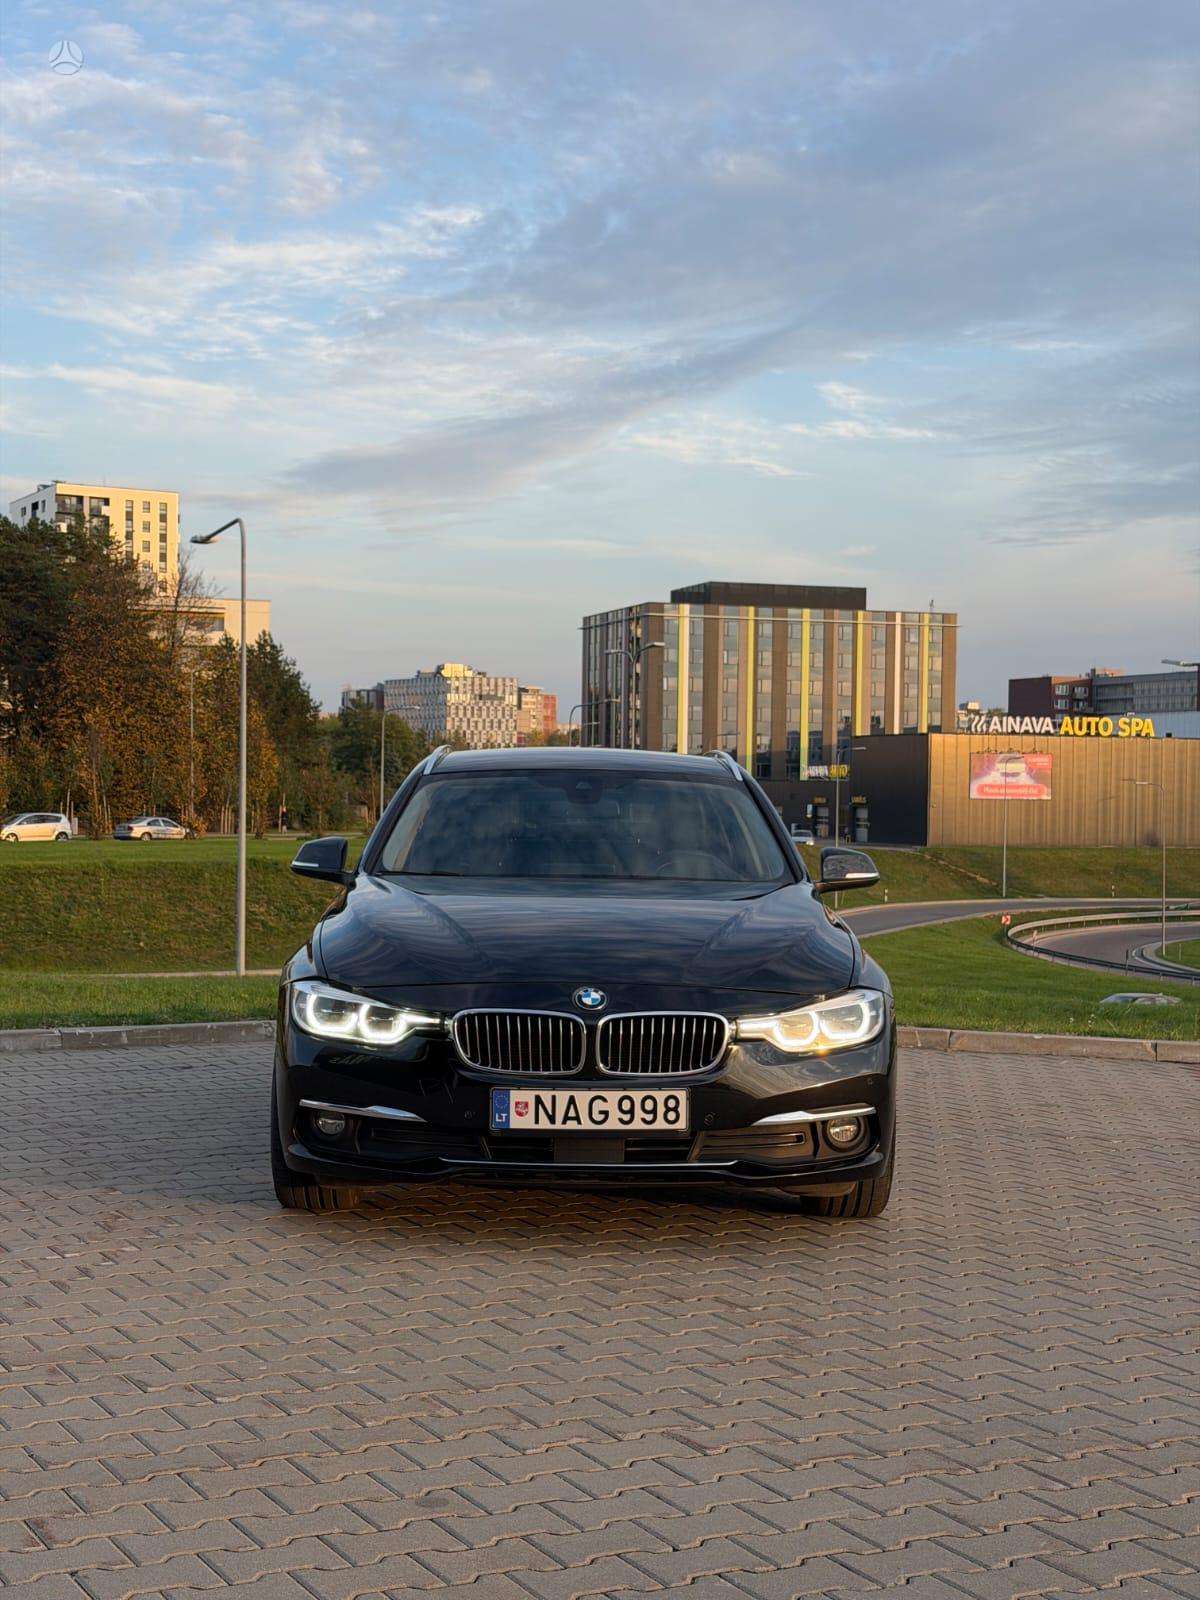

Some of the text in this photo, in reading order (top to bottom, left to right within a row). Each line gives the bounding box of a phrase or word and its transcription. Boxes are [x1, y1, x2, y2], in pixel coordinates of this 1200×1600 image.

[1059, 716, 1114, 737] AUTO
[1118, 717, 1156, 738] SPA
[495, 1113, 508, 1122] LT
[533, 1094, 681, 1126] NAG998
